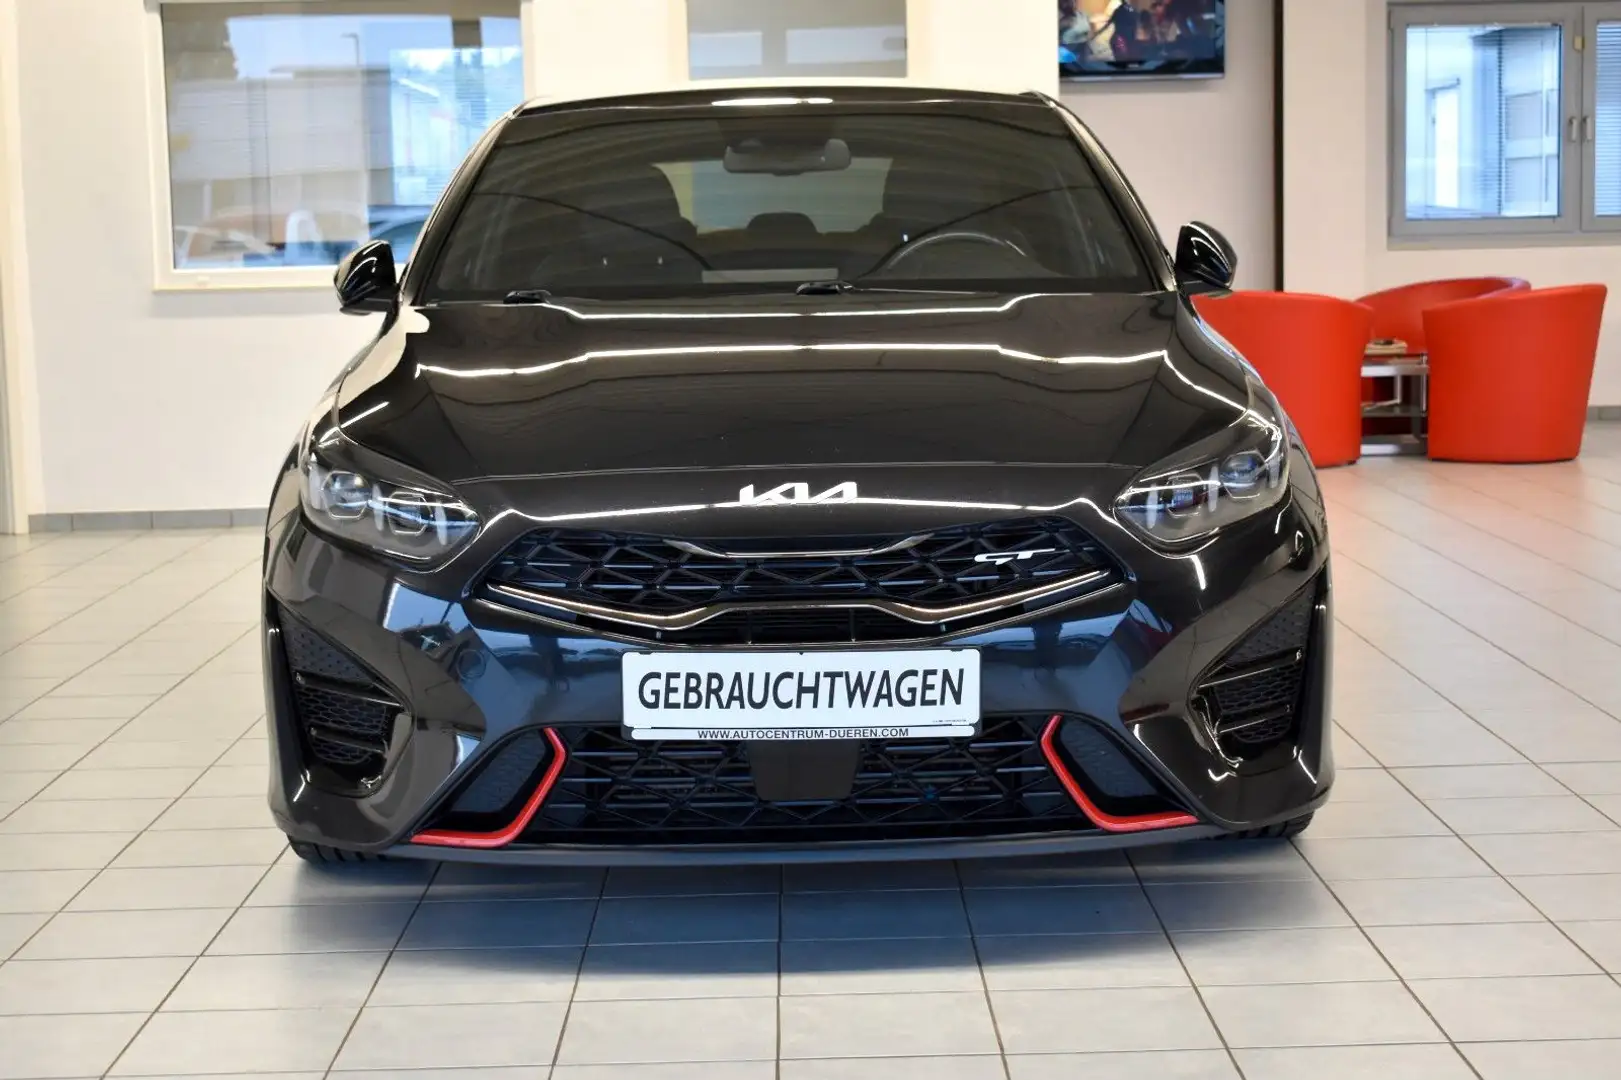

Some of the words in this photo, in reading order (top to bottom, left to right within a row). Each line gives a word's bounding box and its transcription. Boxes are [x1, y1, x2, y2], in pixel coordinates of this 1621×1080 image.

[739, 481, 858, 504] KIA
[974, 547, 1055, 566] GT
[638, 668, 965, 710] GEBRAUCHTWAGEN
[697, 727, 909, 739] WWW.AUTOCENTRUM-DUEREN.COM
